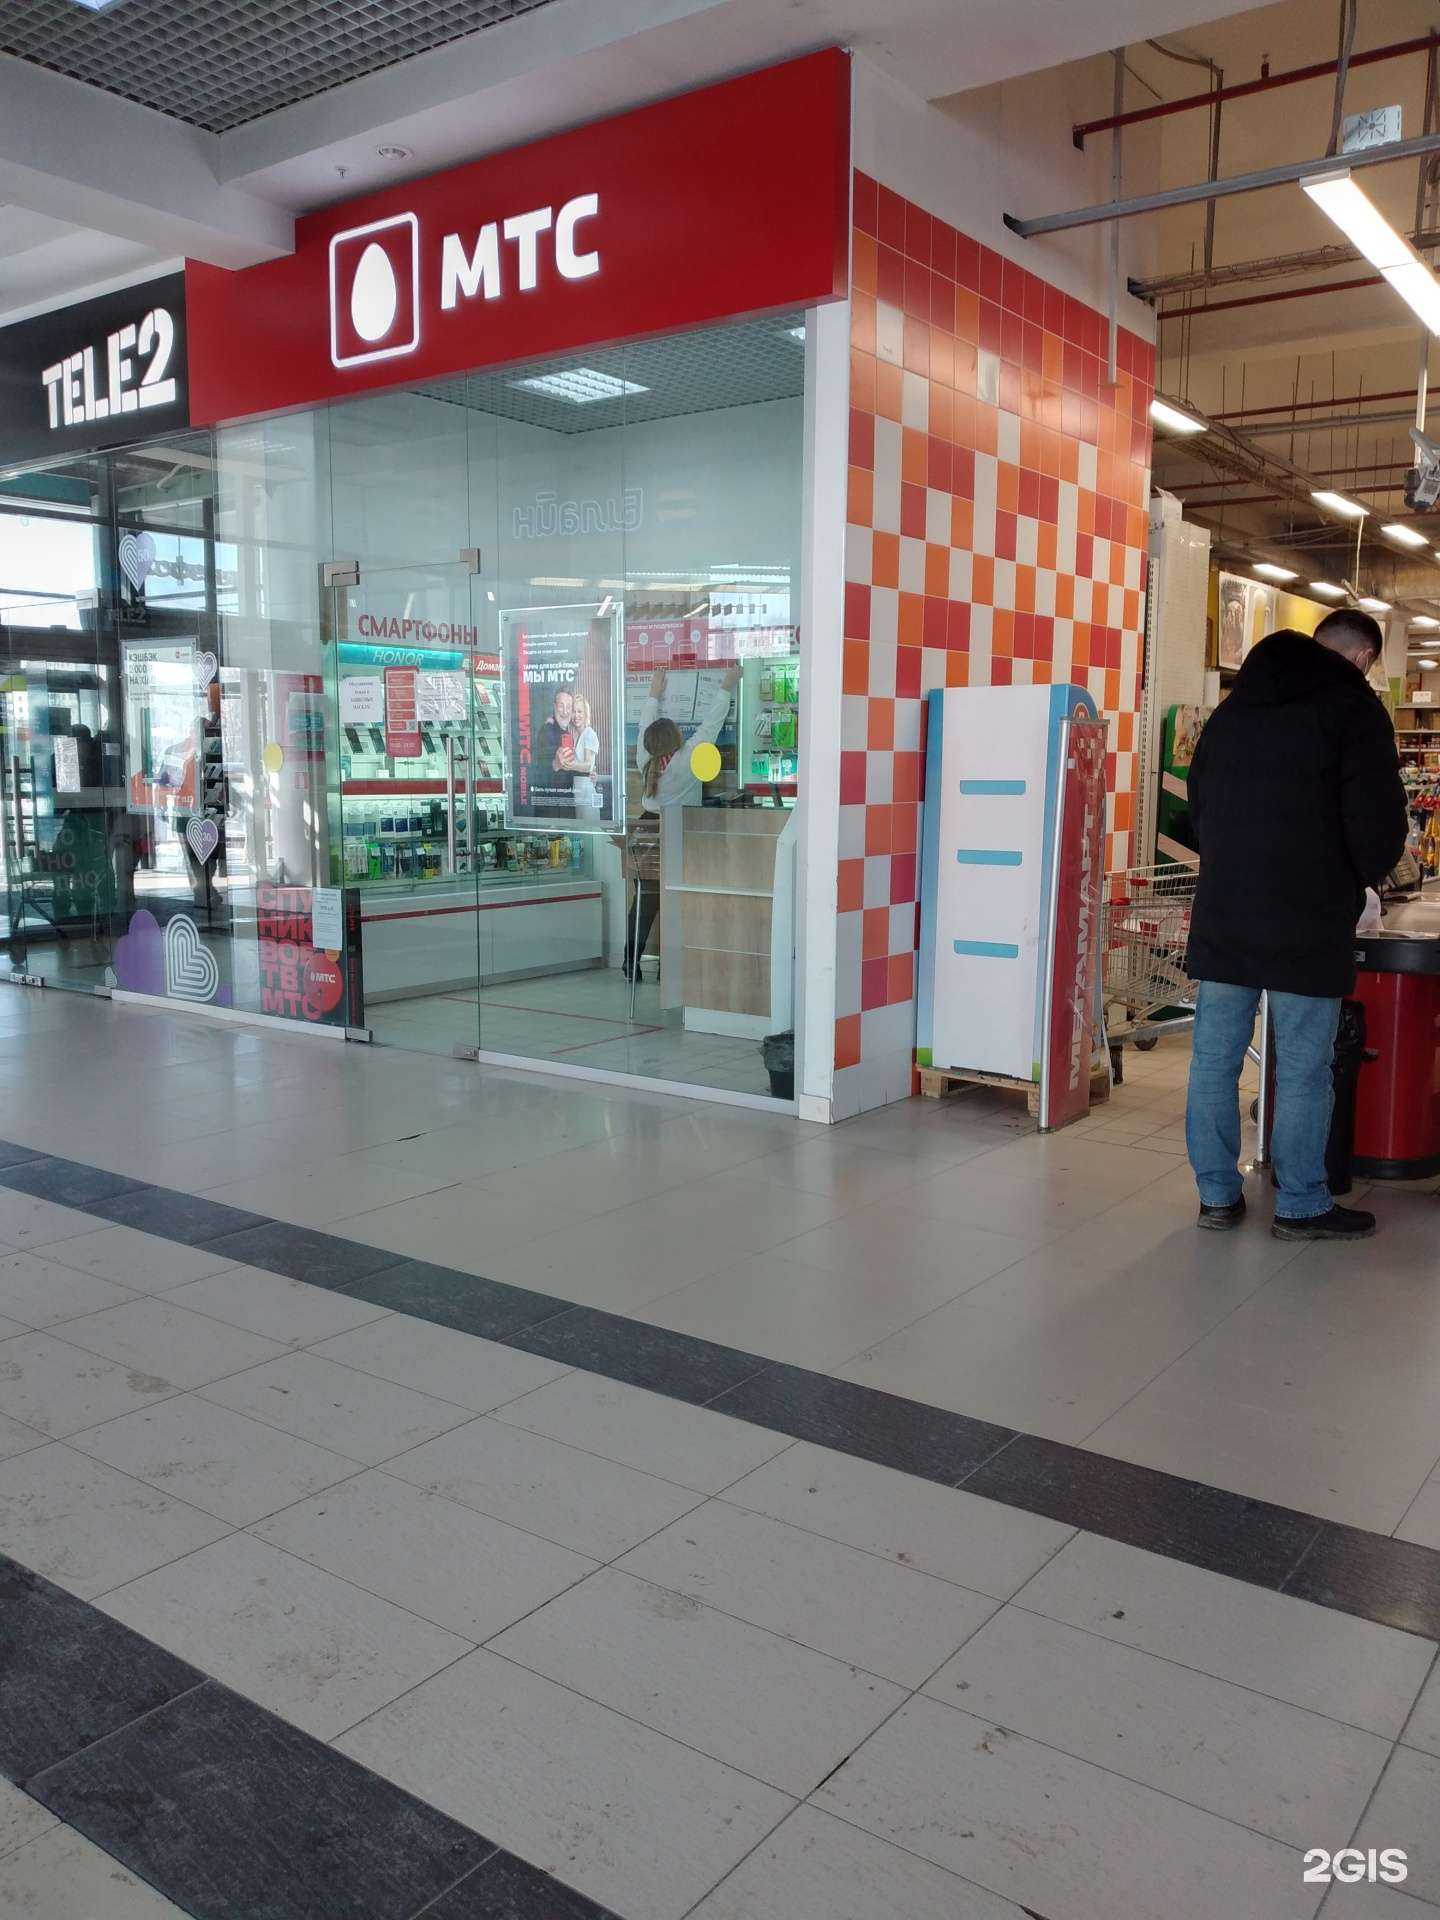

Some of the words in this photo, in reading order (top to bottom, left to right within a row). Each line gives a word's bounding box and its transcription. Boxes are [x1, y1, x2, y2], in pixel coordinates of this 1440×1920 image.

[441, 193, 599, 310] МТС
[42, 308, 175, 429] TELE2
[358, 614, 478, 645] СМАРТФОНЫ
[372, 649, 424, 666] HONOR
[522, 670, 545, 683] МЫ
[547, 669, 575, 682] МТС
[257, 882, 313, 914] СПУ
[258, 909, 313, 941] НИК
[1069, 803, 1094, 1091] МЕГАМАРТ
[260, 962, 298, 991] ТВ
